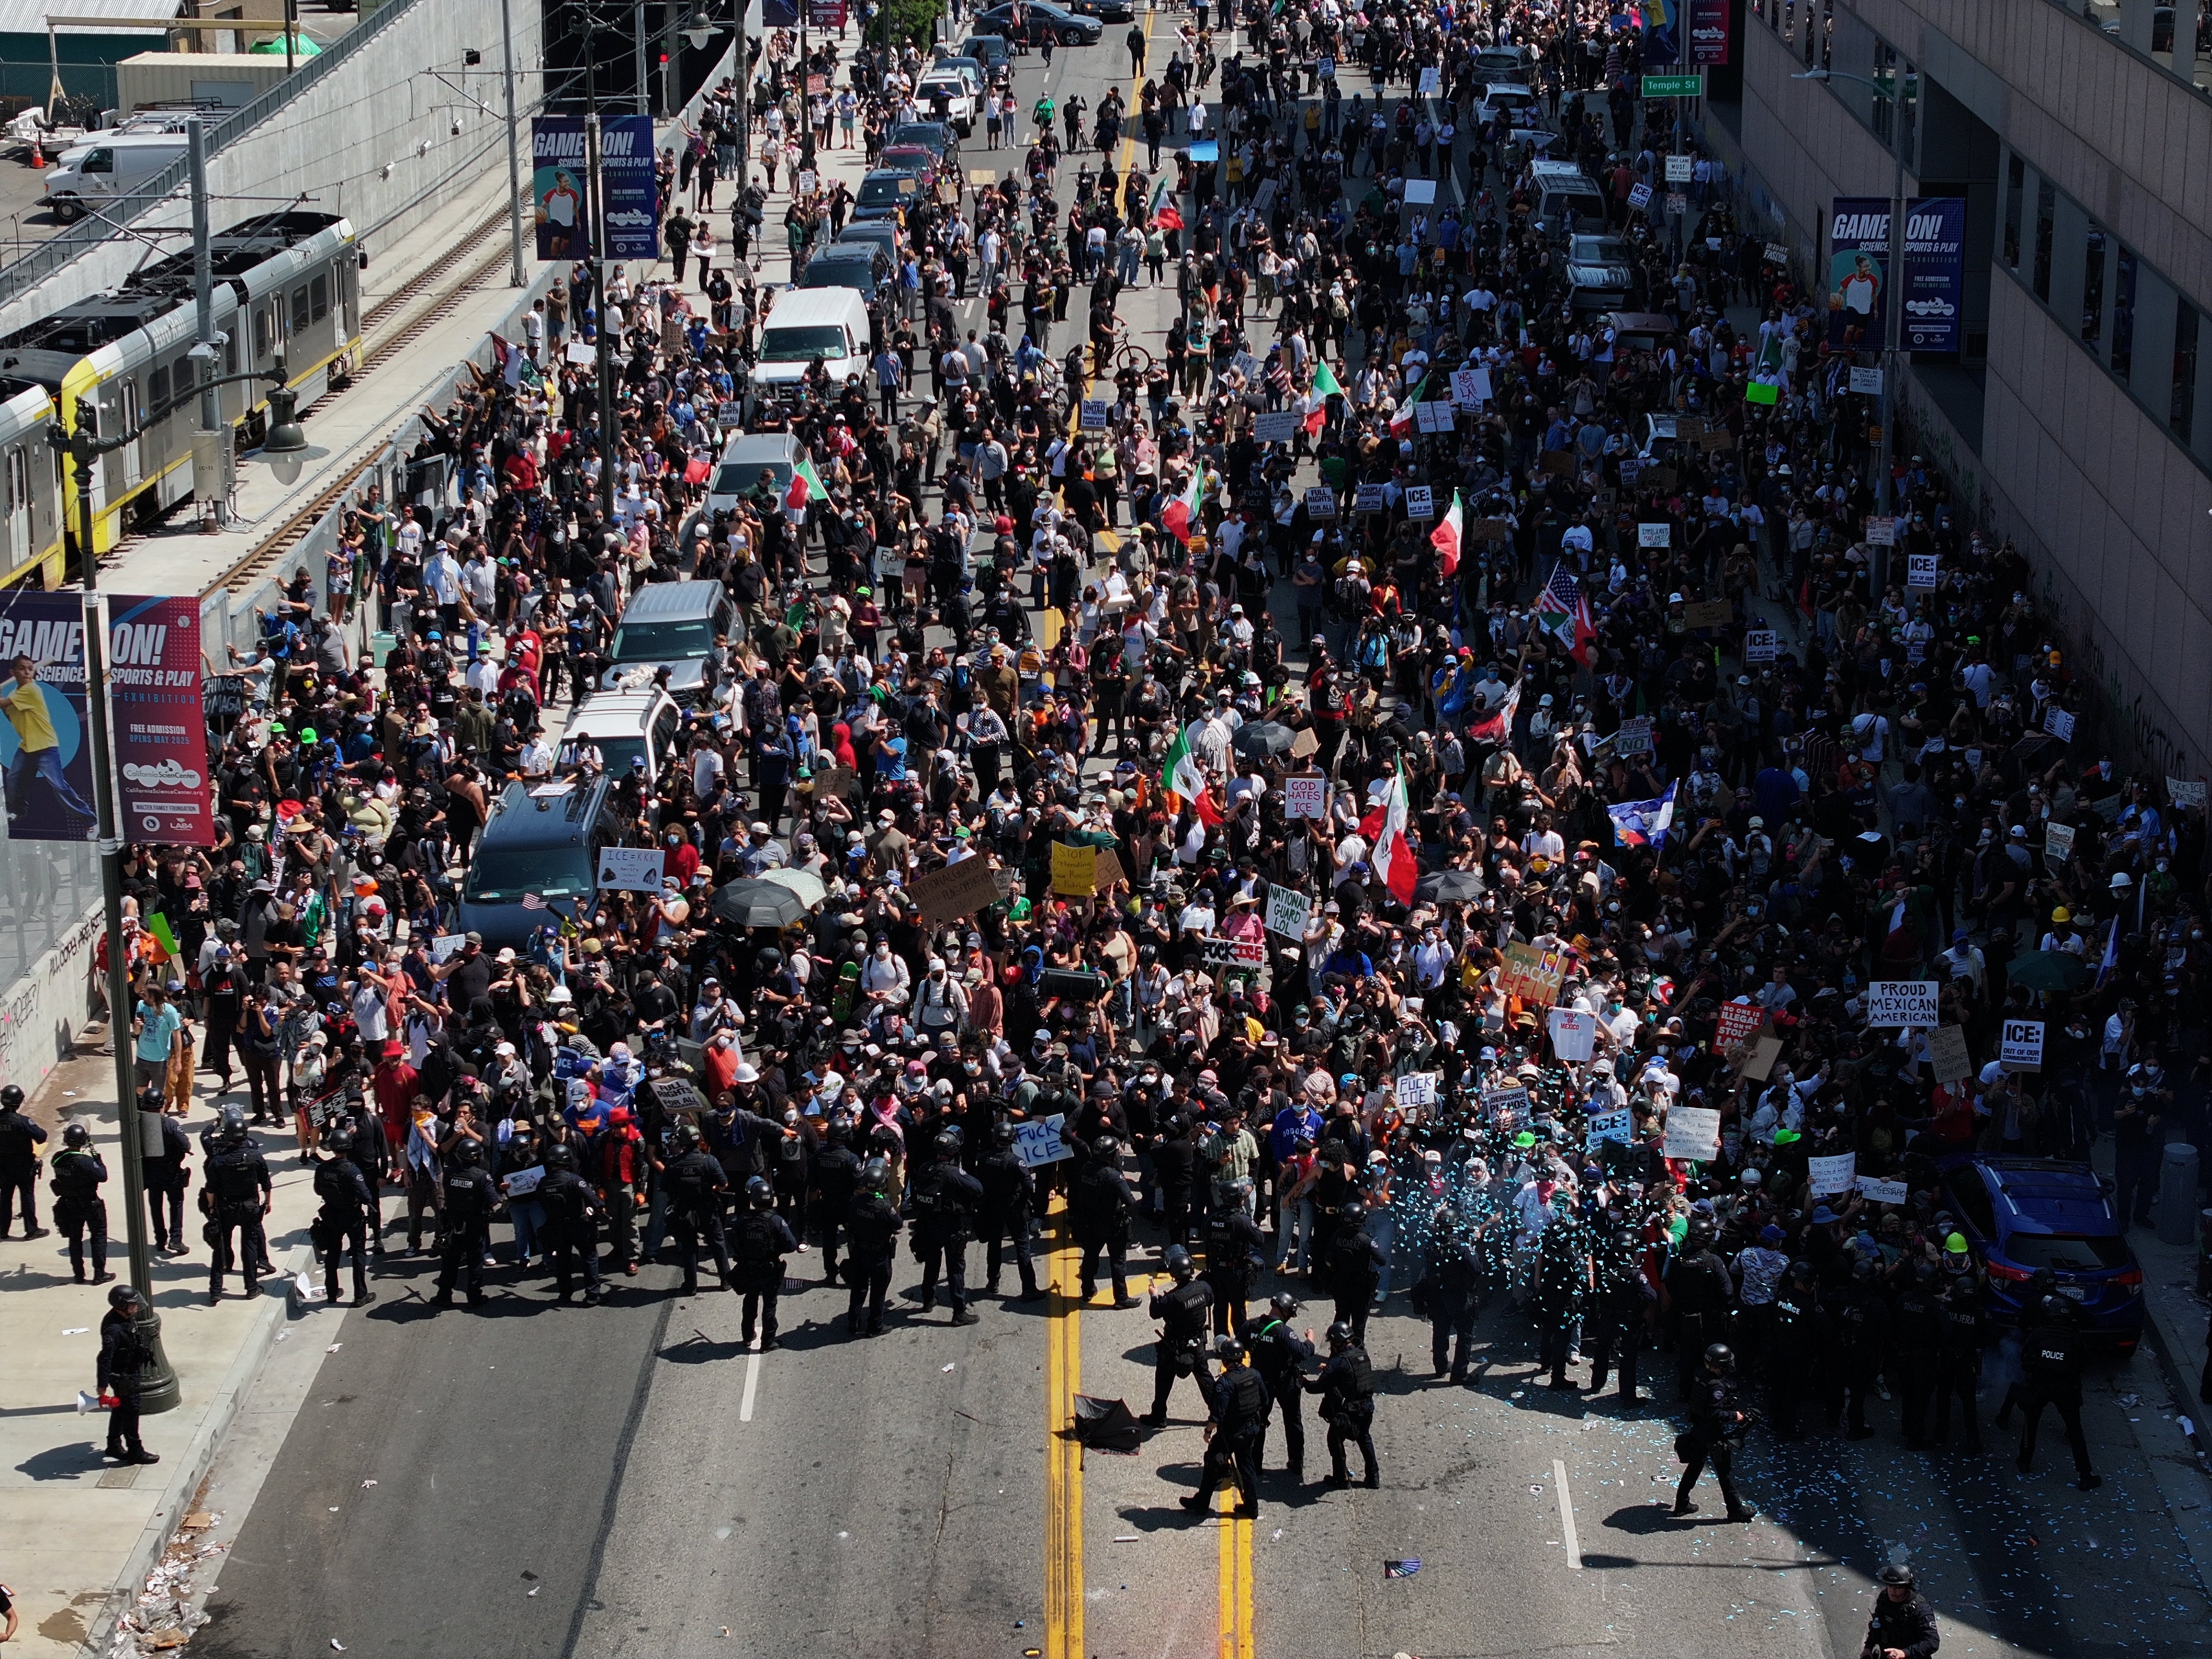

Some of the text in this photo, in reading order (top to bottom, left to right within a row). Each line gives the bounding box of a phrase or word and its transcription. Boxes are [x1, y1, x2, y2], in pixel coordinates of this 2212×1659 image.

[1647, 80, 1696, 91] Temple St
[533, 132, 634, 156] GAME ON!
[600, 157, 651, 167] SPORTS & PLAY
[1633, 185, 1650, 198] ICE:
[1832, 215, 1943, 240] GAME ON!
[1904, 241, 1932, 253] SPORTS
[1933, 242, 1939, 252] &
[1940, 242, 1959, 253] PLAY
[1407, 489, 1430, 503] ICE:
[1910, 557, 1934, 572] ICE:
[0, 619, 167, 666] GAME ON!
[1748, 633, 1774, 647] ICE:
[36, 667, 195, 687] SCIENCE, SPORTS & PLAY
[201, 678, 244, 695] CHINGA
[124, 692, 195, 704] EXHIBITION
[130, 724, 186, 735] FREE ADMISSION
[2062, 714, 2074, 741] FEDS
[129, 735, 190, 745] OPENS MAY 2025
[1621, 738, 1645, 752] NO
[820, 774, 845, 783] FUCK
[125, 787, 204, 797] CaliforniaScienceCenter.org
[823, 784, 838, 794] ICE
[1291, 781, 1316, 791] GOD
[2190, 782, 2205, 793] ICE
[1288, 791, 1321, 802] HATES
[168, 804, 196, 812] FOUNDATION
[1294, 802, 1312, 813] ICE
[1059, 847, 1086, 859] STOP
[1269, 885, 1307, 912] NATIONAL
[1274, 904, 1301, 924] GUARD
[1273, 918, 1290, 935] LOL
[434, 938, 459, 953] GET
[1202, 943, 1263, 963] FUCK ICE
[1511, 961, 1560, 988] BACK 2
[1502, 970, 1554, 1006] HELL
[1881, 983, 1927, 997] PROUD
[1870, 997, 1937, 1012] MEXICAN
[1721, 1011, 1759, 1026] ILLEGAL
[1736, 1008, 1751, 1017] ONE
[1871, 1011, 1936, 1022] AMERICAN
[2005, 1024, 2041, 1044] ICE:
[659, 1081, 679, 1092] FULL
[1400, 1076, 1434, 1091] FUCK
[657, 1087, 693, 1098] RIGHTS
[1399, 1089, 1427, 1106] ICE
[1489, 1091, 1526, 1105] DERECHOS
[663, 1097, 678, 1107] FOR
[678, 1096, 696, 1104] ALL
[1590, 1114, 1627, 1133] ICE:
[1016, 1121, 1059, 1143] FUCK
[1023, 1143, 1063, 1163] ICE
[1856, 1182, 1871, 1191] ICE
[916, 1194, 934, 1204] POLICE
[1335, 1237, 1361, 1251] ALCARAZ
[2041, 1349, 2065, 1361] POLICE
